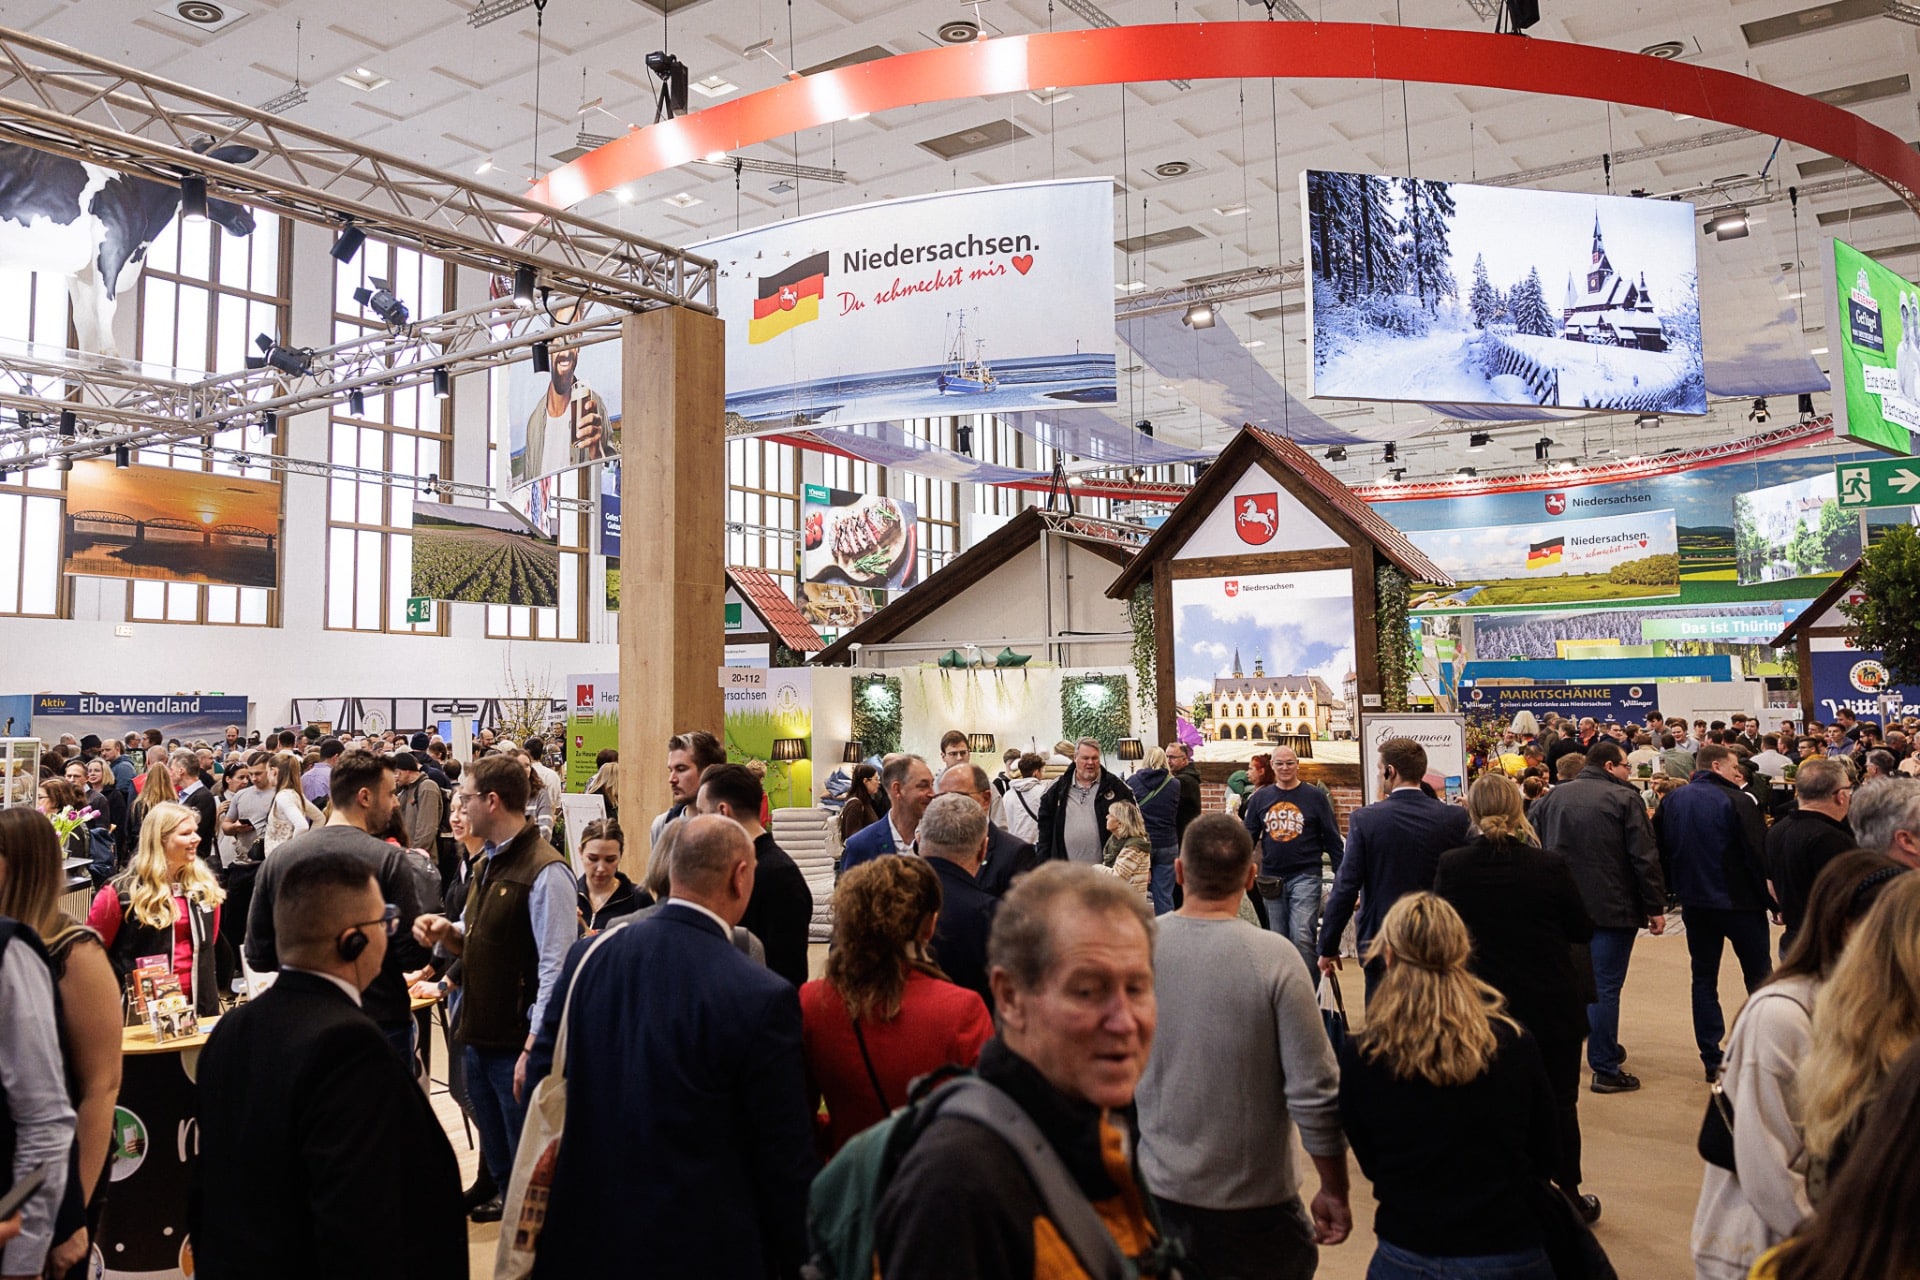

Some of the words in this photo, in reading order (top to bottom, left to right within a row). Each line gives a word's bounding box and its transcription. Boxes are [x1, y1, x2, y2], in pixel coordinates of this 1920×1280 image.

[843, 233, 1040, 274] Niedersachsen.
[836, 291, 866, 317] Du
[873, 266, 964, 305] schmeckst
[968, 260, 1007, 281] mir
[1572, 493, 1652, 507] Niedersachsen
[1570, 531, 1650, 546] Niedersachsen.
[1242, 582, 1295, 592] Niedersachsen
[1681, 621, 1708, 634] Das
[1711, 620, 1729, 633] ist
[1732, 619, 1786, 636] Thüring
[731, 673, 761, 684] 20-112
[724, 688, 767, 701] ersachsen
[1499, 686, 1611, 700] MARKTSCHÄNKE
[40, 697, 66, 707] Aktiv
[79, 697, 201, 714] Elbe-Wendland
[1533, 700, 1559, 708] Getränke
[1570, 700, 1612, 708] Niedersachsen
[1619, 699, 1654, 708] Wittinger
[1265, 820, 1304, 835] JONES
